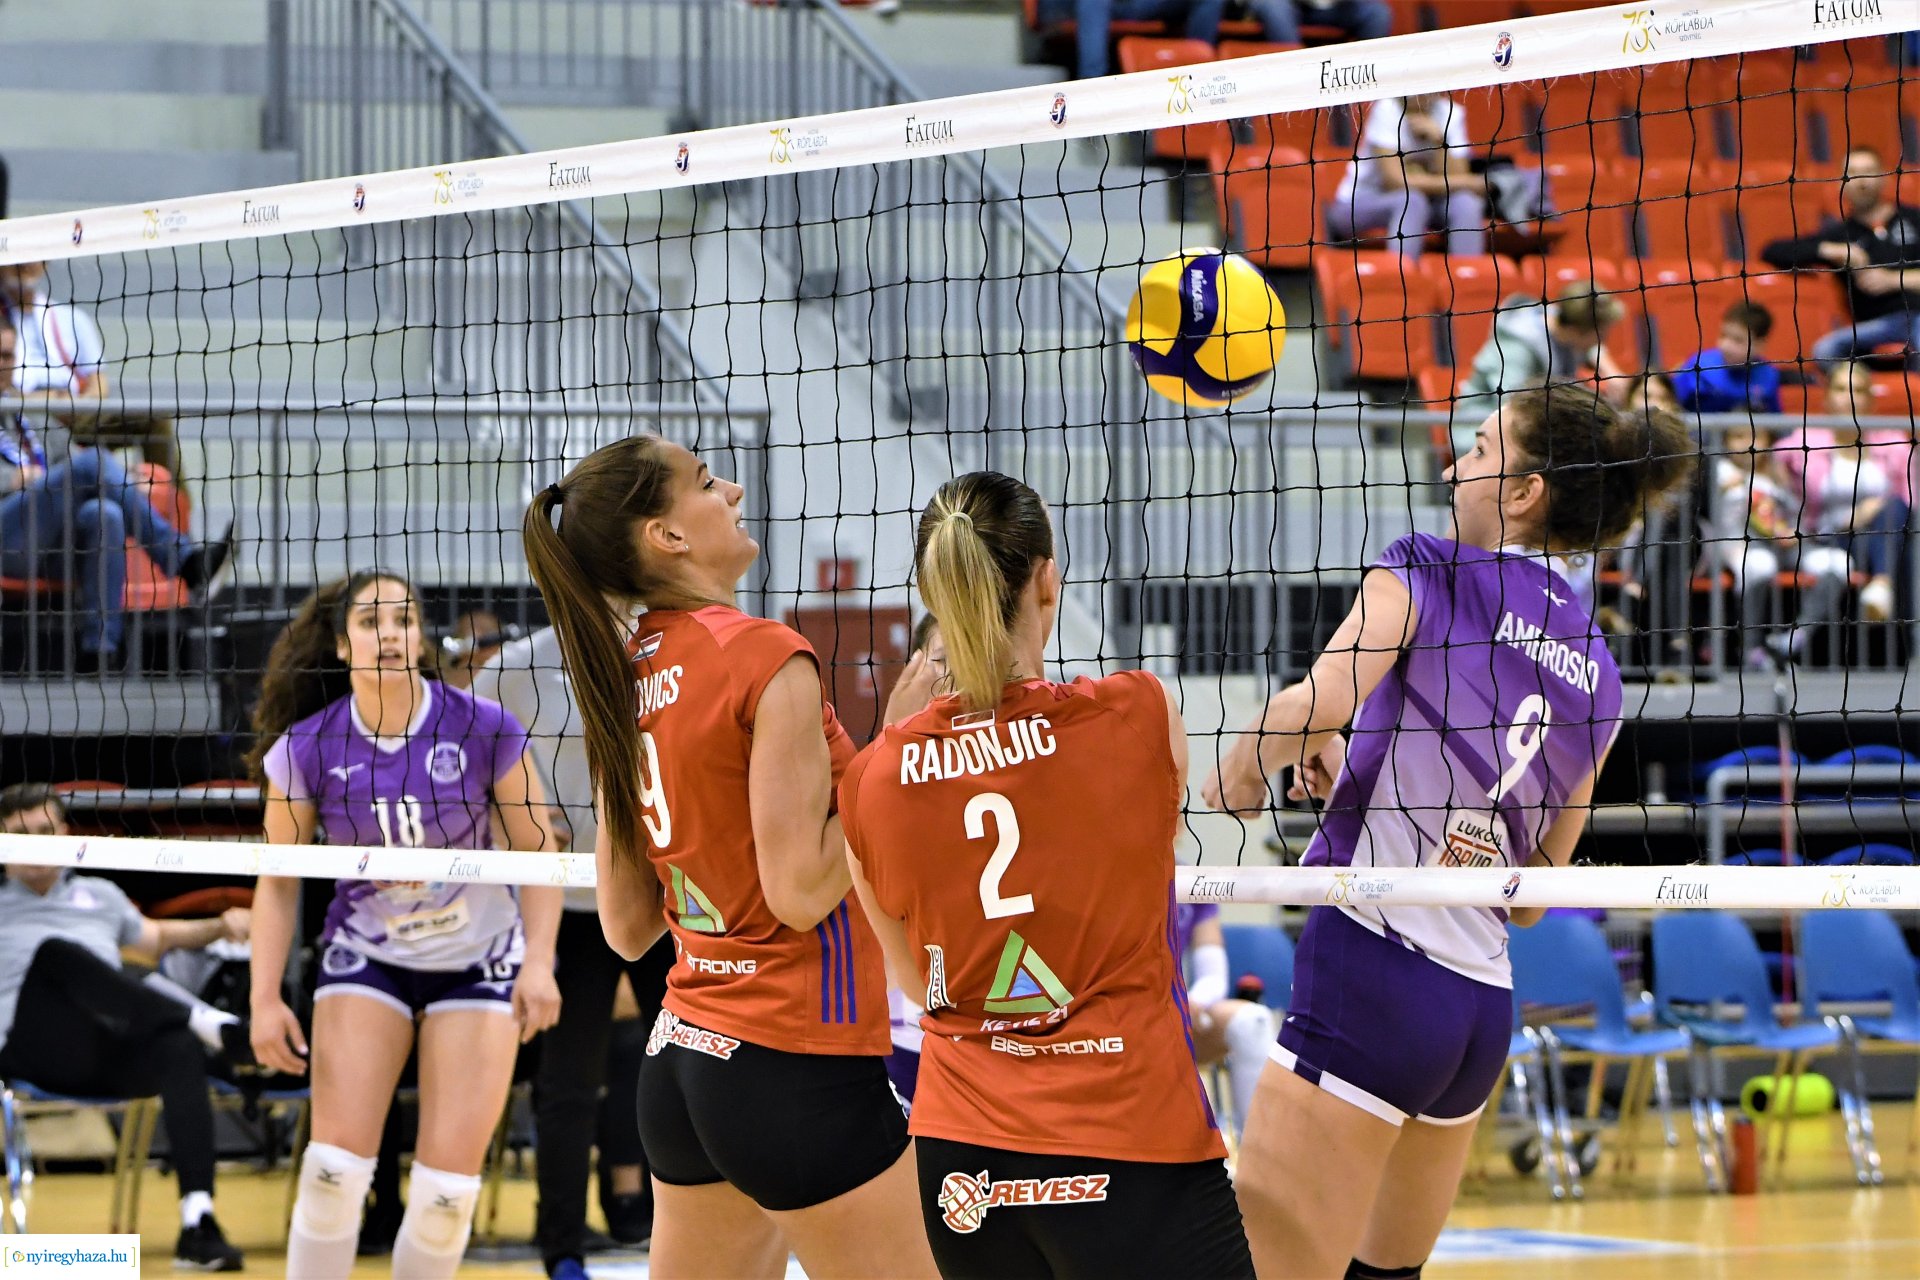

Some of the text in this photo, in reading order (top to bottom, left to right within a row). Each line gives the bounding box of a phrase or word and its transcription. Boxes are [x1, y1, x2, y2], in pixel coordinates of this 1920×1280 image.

[1813, 0, 1882, 23] FATUM
[1319, 58, 1378, 90] FATUM
[905, 114, 954, 143] FATUM
[549, 160, 591, 187] FATUM
[243, 200, 280, 223] FATUM
[1494, 611, 1600, 695] AMBROSIO
[1487, 694, 1552, 801] 9
[638, 731, 672, 849] 9
[371, 794, 426, 848] 18
[1456, 820, 1503, 847] LUKOIL
[963, 792, 1035, 920] 2
[1188, 875, 1235, 897] FATUM
[1655, 876, 1709, 899] FATUM
[672, 1026, 740, 1059] REVESZ
[990, 1035, 1124, 1057] BESTRONG
[988, 1176, 1109, 1204] REVESZ
